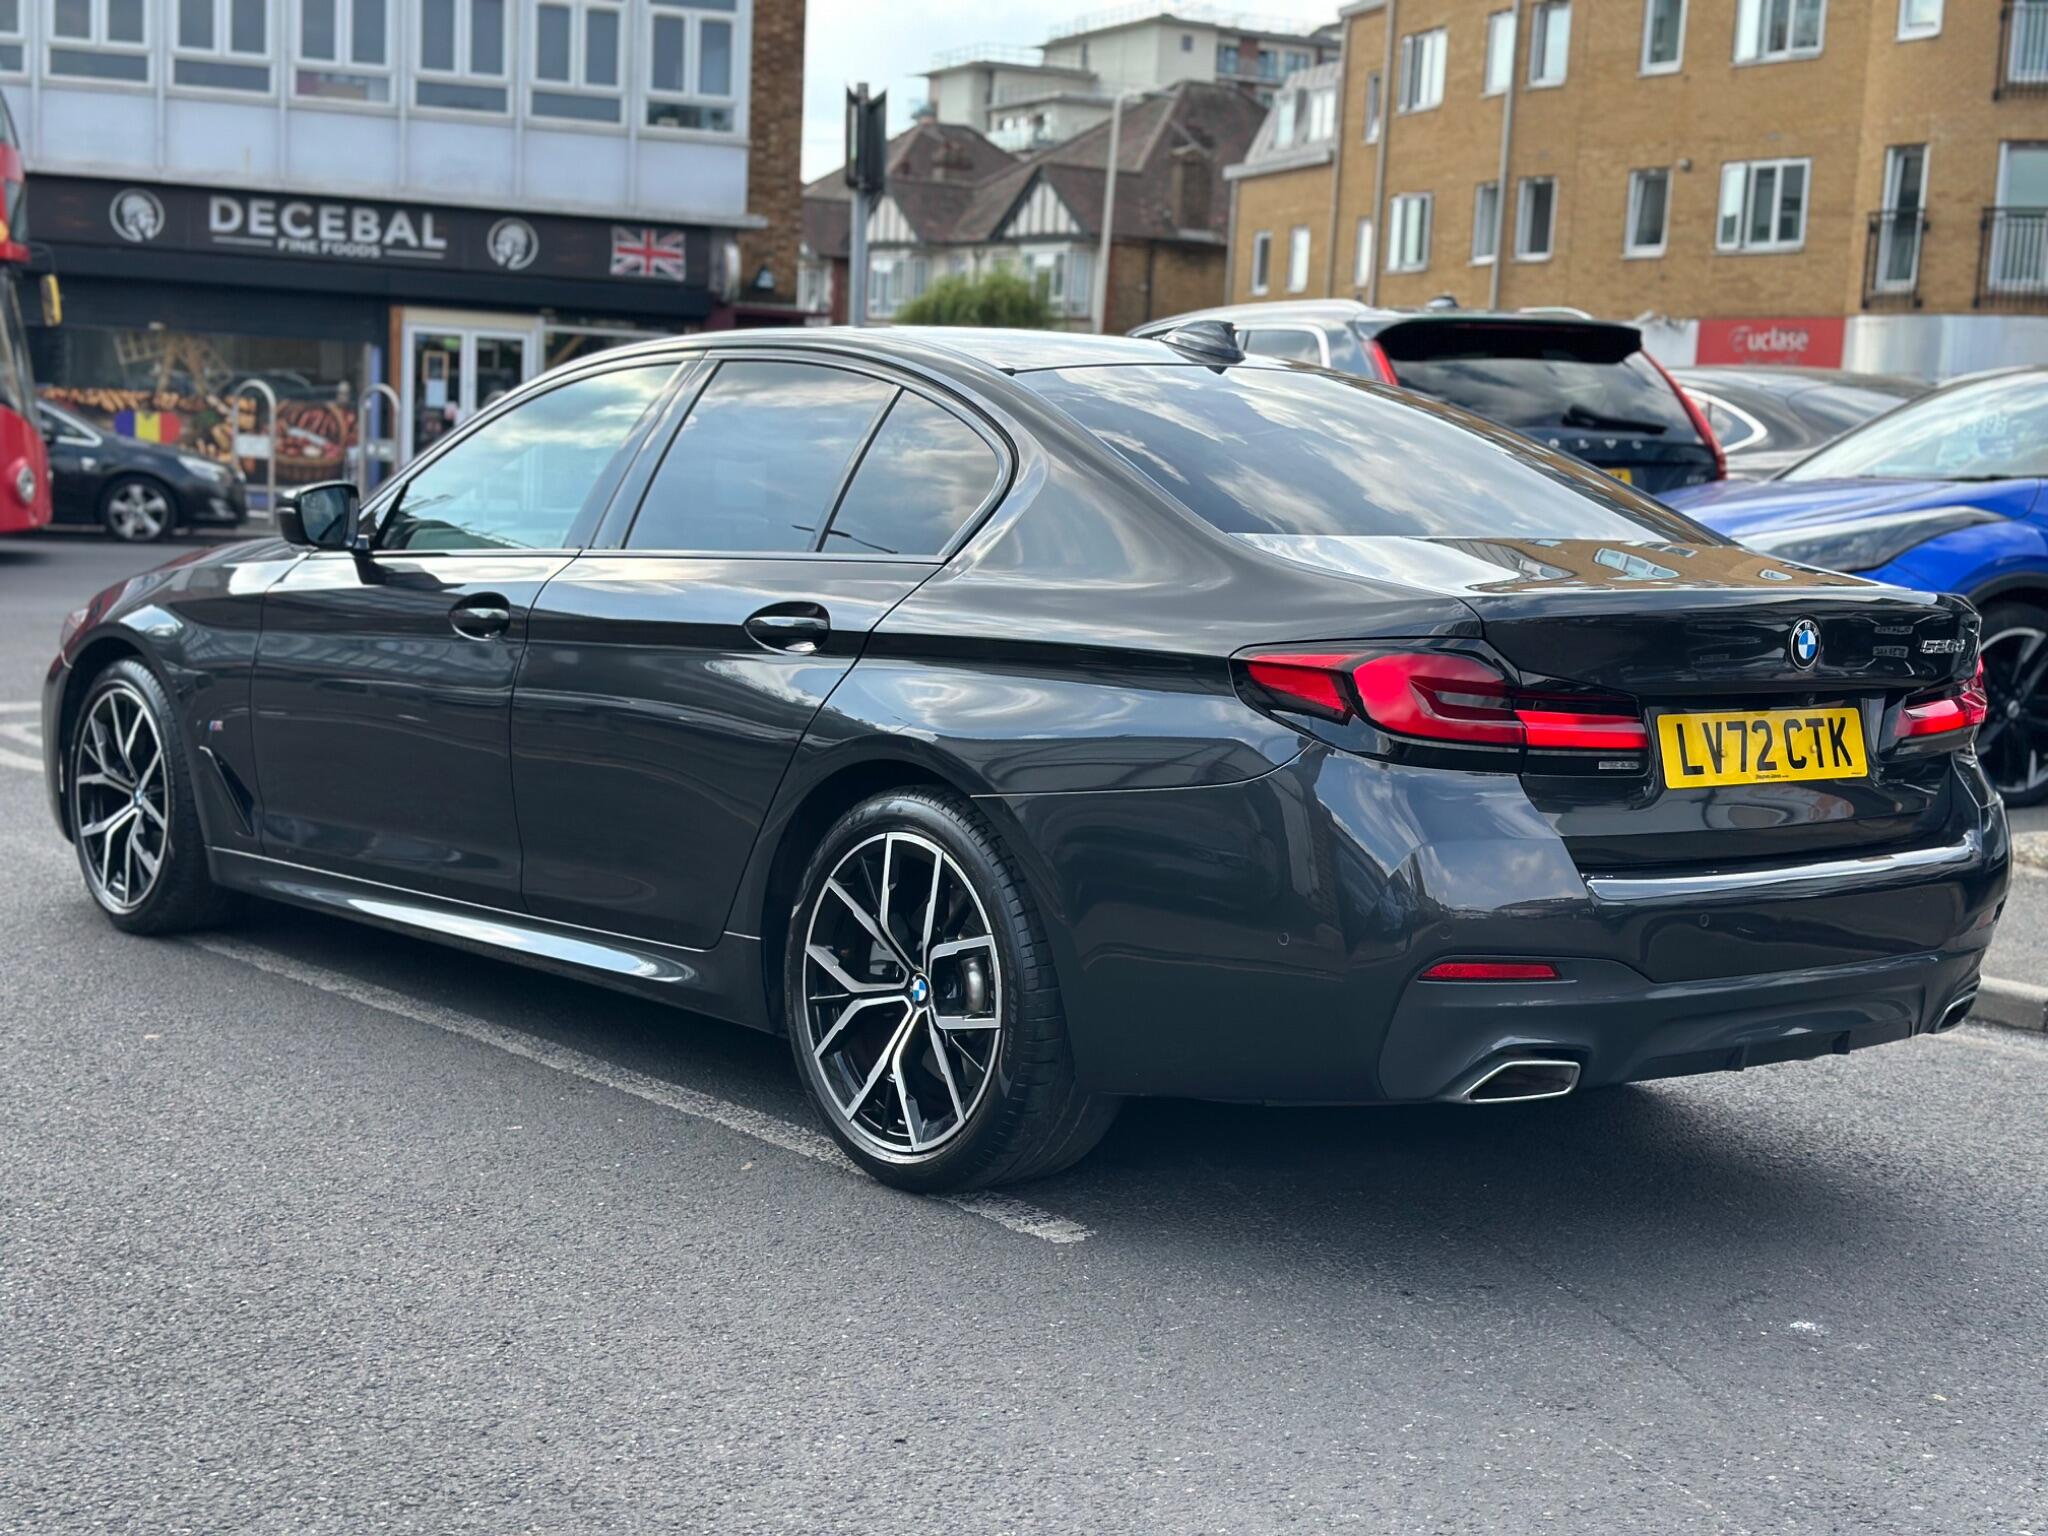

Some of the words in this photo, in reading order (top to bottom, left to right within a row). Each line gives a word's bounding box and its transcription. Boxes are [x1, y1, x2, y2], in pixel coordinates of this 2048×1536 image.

[209, 197, 447, 248] DECEBAL
[278, 237, 319, 254] FINE
[321, 241, 381, 258] FOODS
[1920, 639, 1965, 654] 520d
[1676, 719, 1778, 776] LV72
[1783, 717, 1853, 770] CTK
